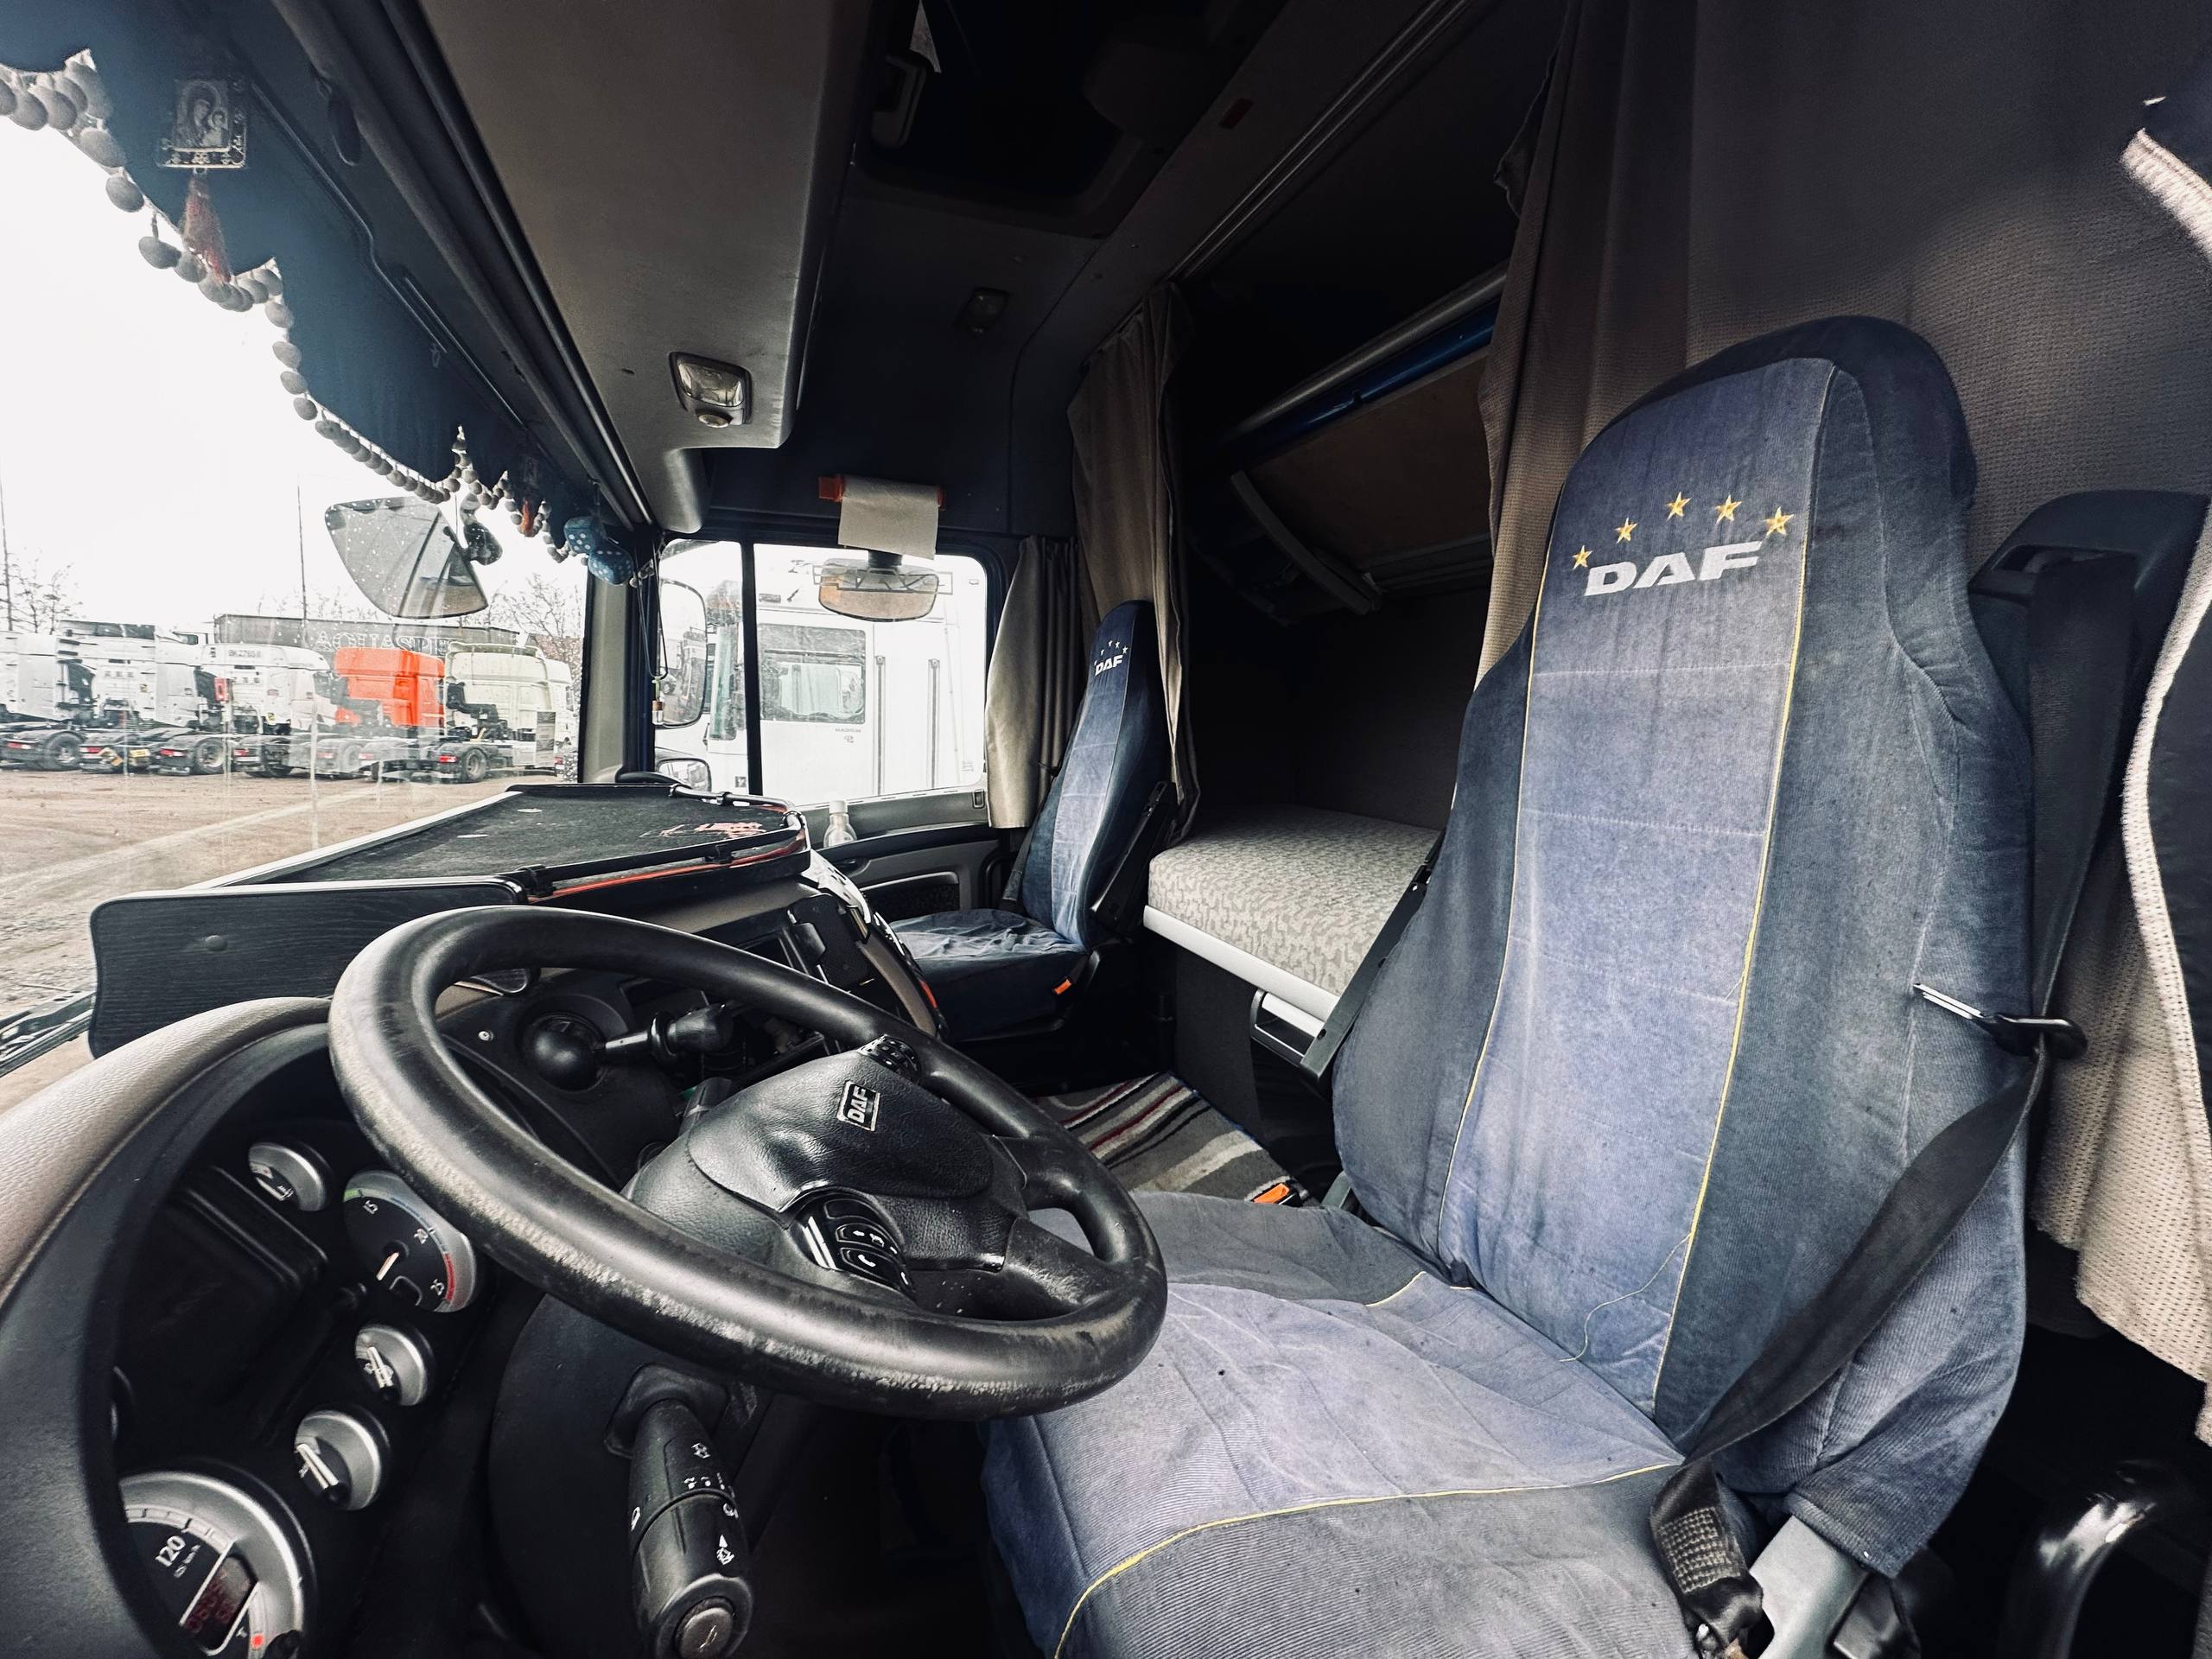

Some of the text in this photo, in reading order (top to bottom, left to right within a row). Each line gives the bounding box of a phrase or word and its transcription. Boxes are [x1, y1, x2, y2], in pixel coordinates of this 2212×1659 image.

[1585, 540, 1763, 596] DAF
[1094, 654, 1123, 677] DAF
[847, 1085, 868, 1124] DAF
[155, 1535, 187, 1567] 120
